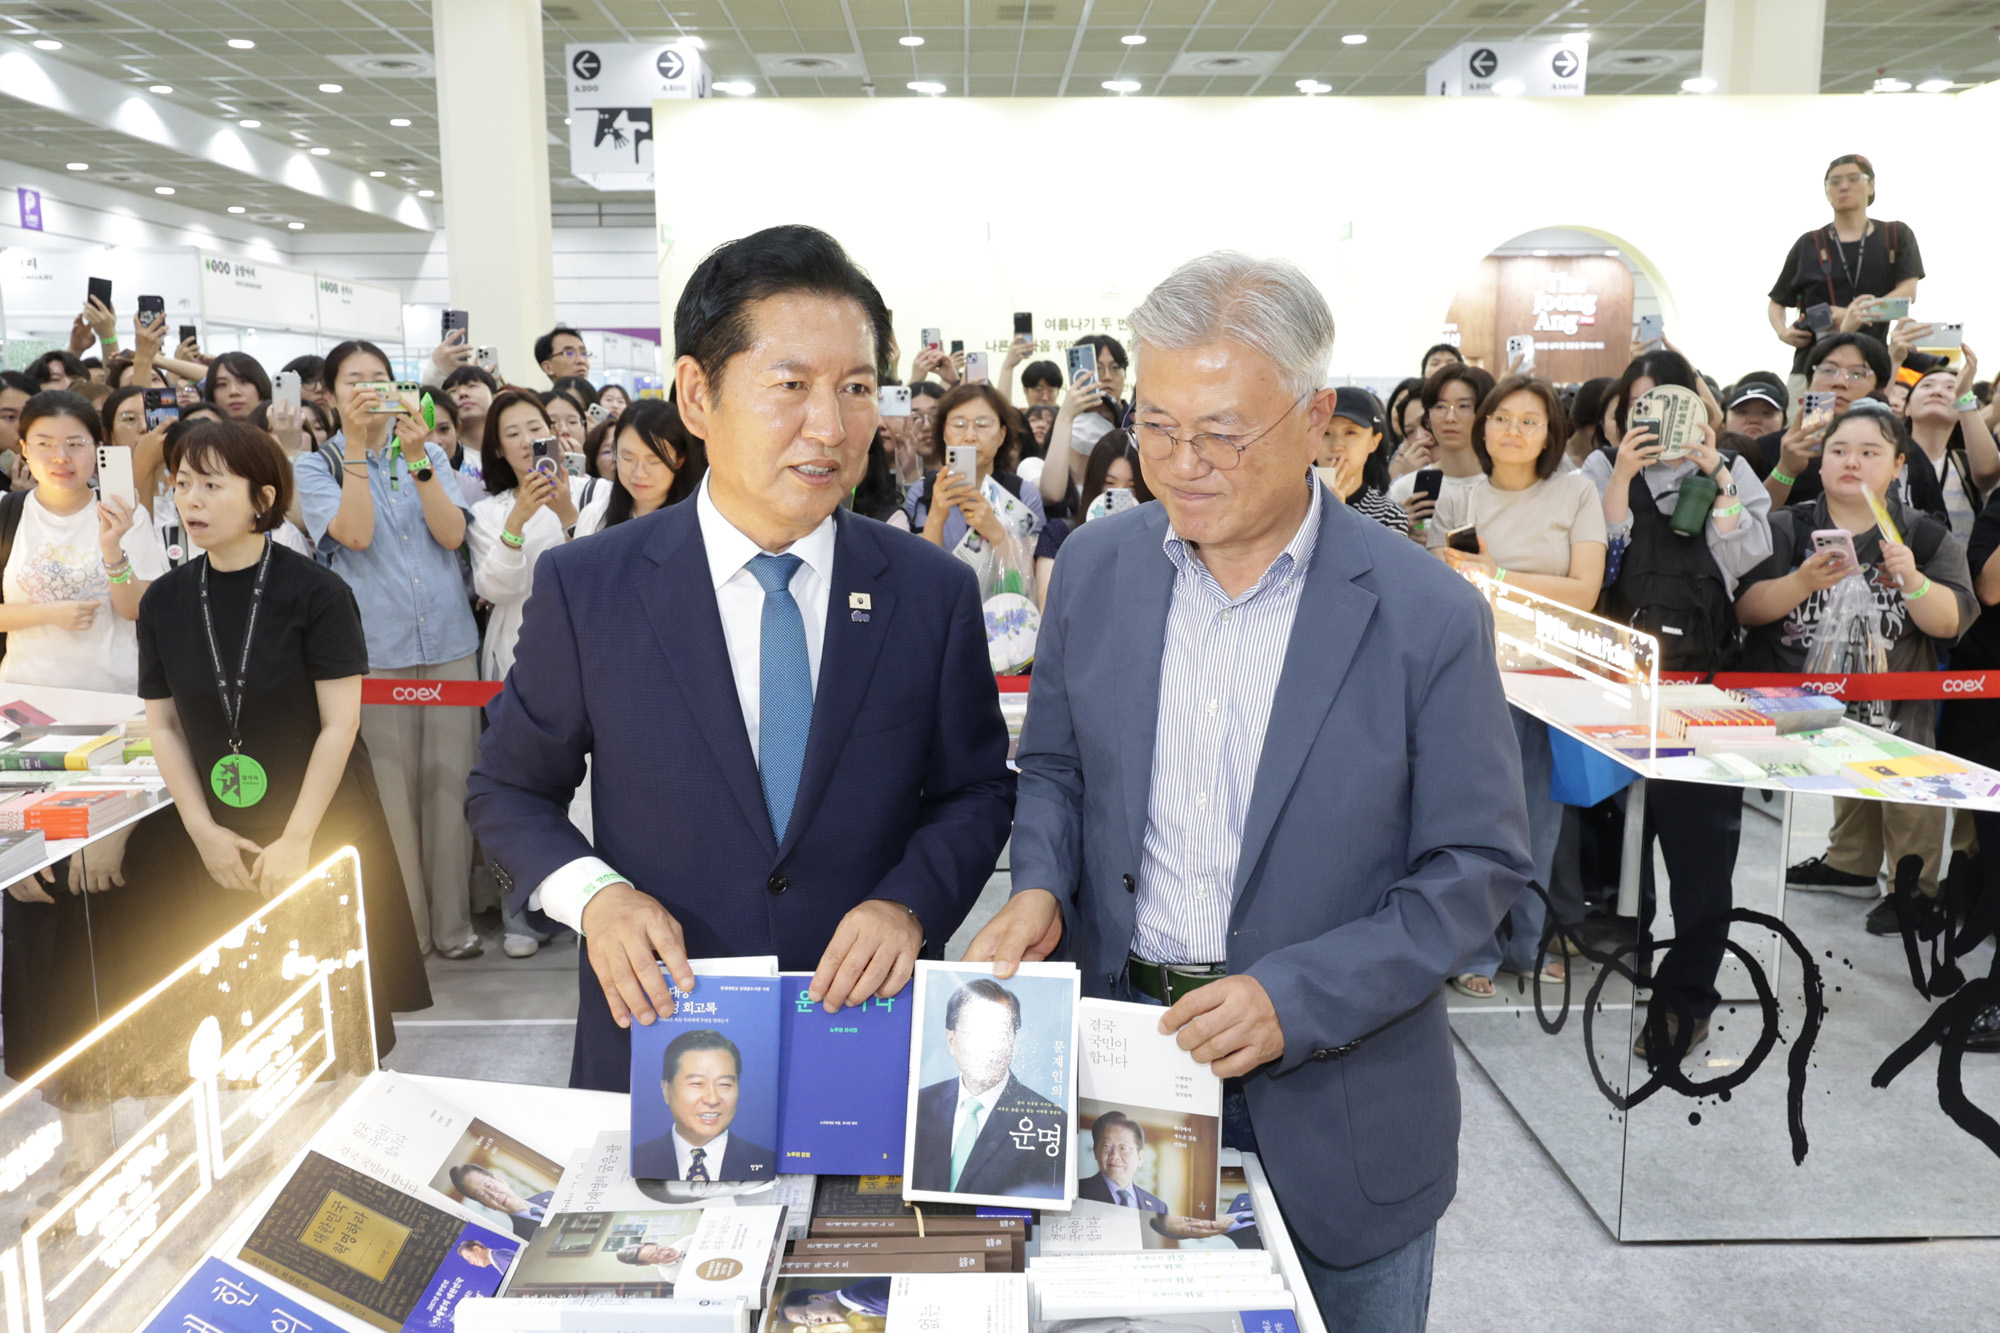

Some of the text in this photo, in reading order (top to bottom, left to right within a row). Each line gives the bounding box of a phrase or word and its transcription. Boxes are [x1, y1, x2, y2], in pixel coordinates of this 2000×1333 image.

[1044, 318, 1095, 331] 여름나기
[1100, 318, 1112, 330] 두
[392, 683, 442, 702] coex
[1943, 675, 1986, 693] coex
[682, 1001, 717, 1015] 회고록
[795, 990, 895, 1013] 운다
[1089, 1019, 1116, 1033] 결국
[1088, 1035, 1127, 1052] 국민이
[1051, 1041, 1065, 1098] 문재인의
[1089, 1051, 1129, 1068] 합니다
[1009, 1116, 1061, 1157] 운명
[583, 1172, 609, 1214] 이재명의
[597, 1153, 618, 1176] 굽은
[314, 1199, 349, 1245] 대한민국
[333, 1209, 369, 1254] 혁명하라
[1068, 1217, 1084, 1242] 국민이
[1085, 1216, 1103, 1242] 합니다
[1050, 1224, 1066, 1242] 결국
